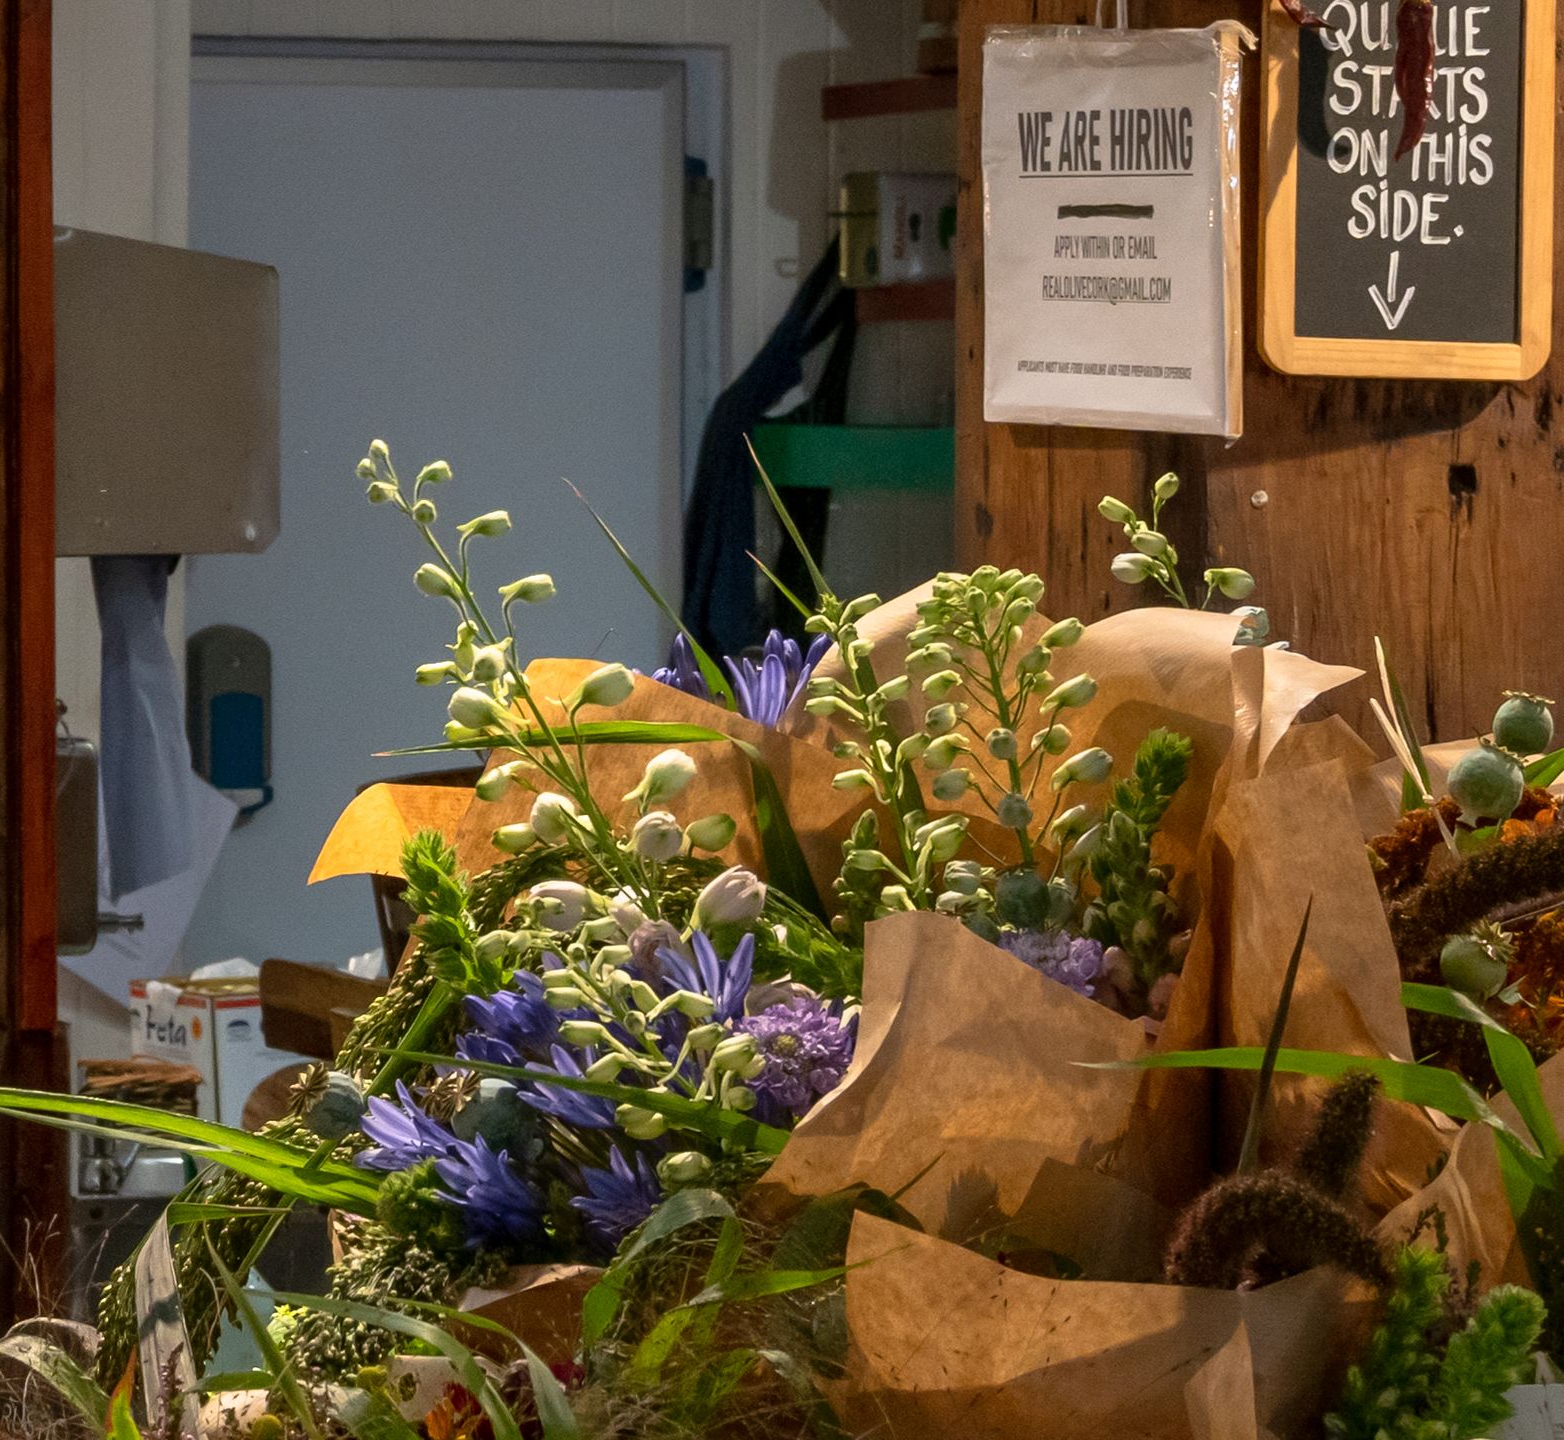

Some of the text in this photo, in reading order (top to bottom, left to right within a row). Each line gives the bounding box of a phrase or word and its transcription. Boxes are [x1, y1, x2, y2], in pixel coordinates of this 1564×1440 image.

[1018, 107, 1193, 172] WE ARE HIRING
[1326, 126, 1389, 178] ON
[1053, 236, 1157, 260] APPLY WITHIN OR EMAIL
